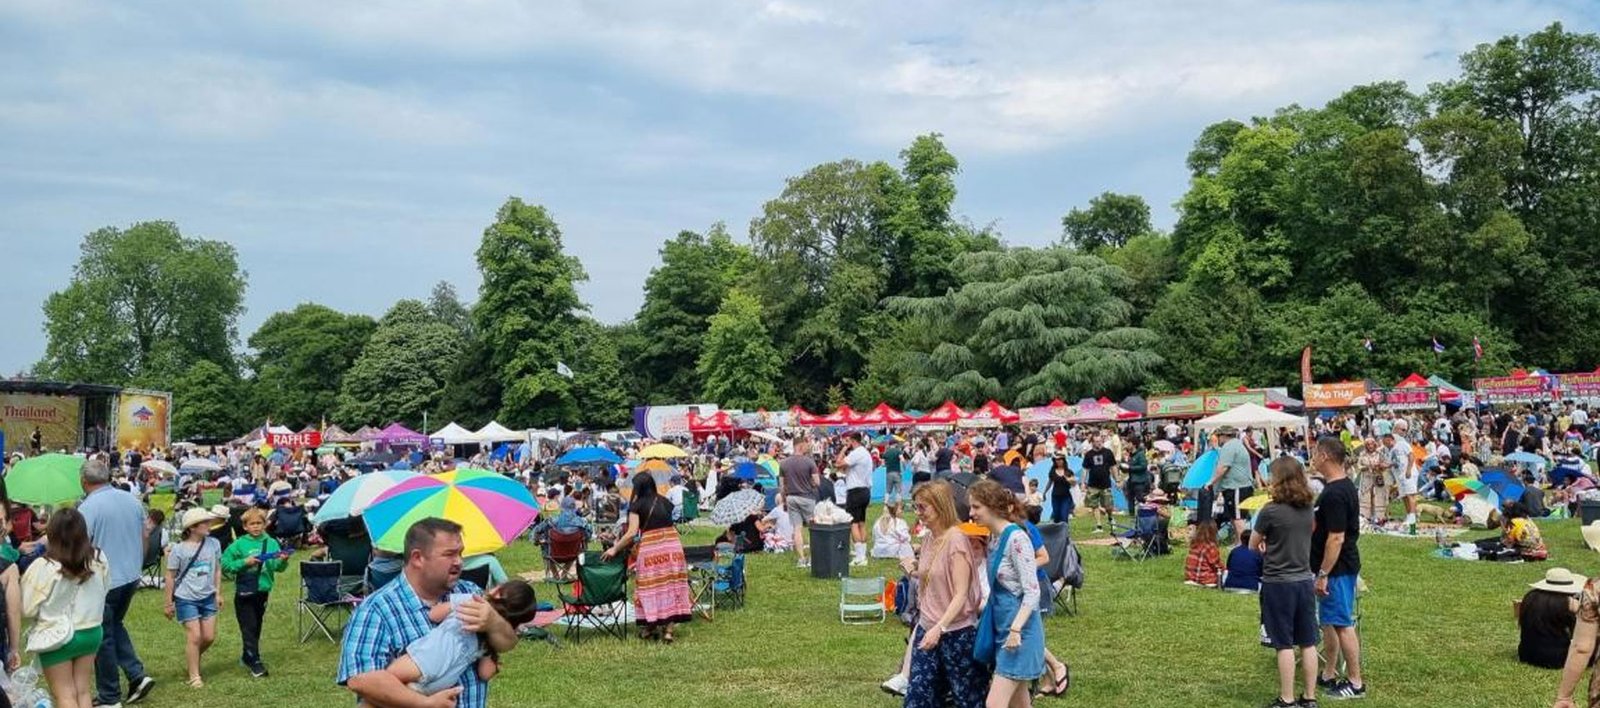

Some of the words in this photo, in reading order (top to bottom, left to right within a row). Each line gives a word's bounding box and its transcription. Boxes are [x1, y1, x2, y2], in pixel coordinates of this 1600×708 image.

[1313, 390, 1332, 399] PAD
[1333, 389, 1353, 398] THAI
[4, 405, 56, 417] Thailand
[273, 433, 311, 445] RAFFLE
